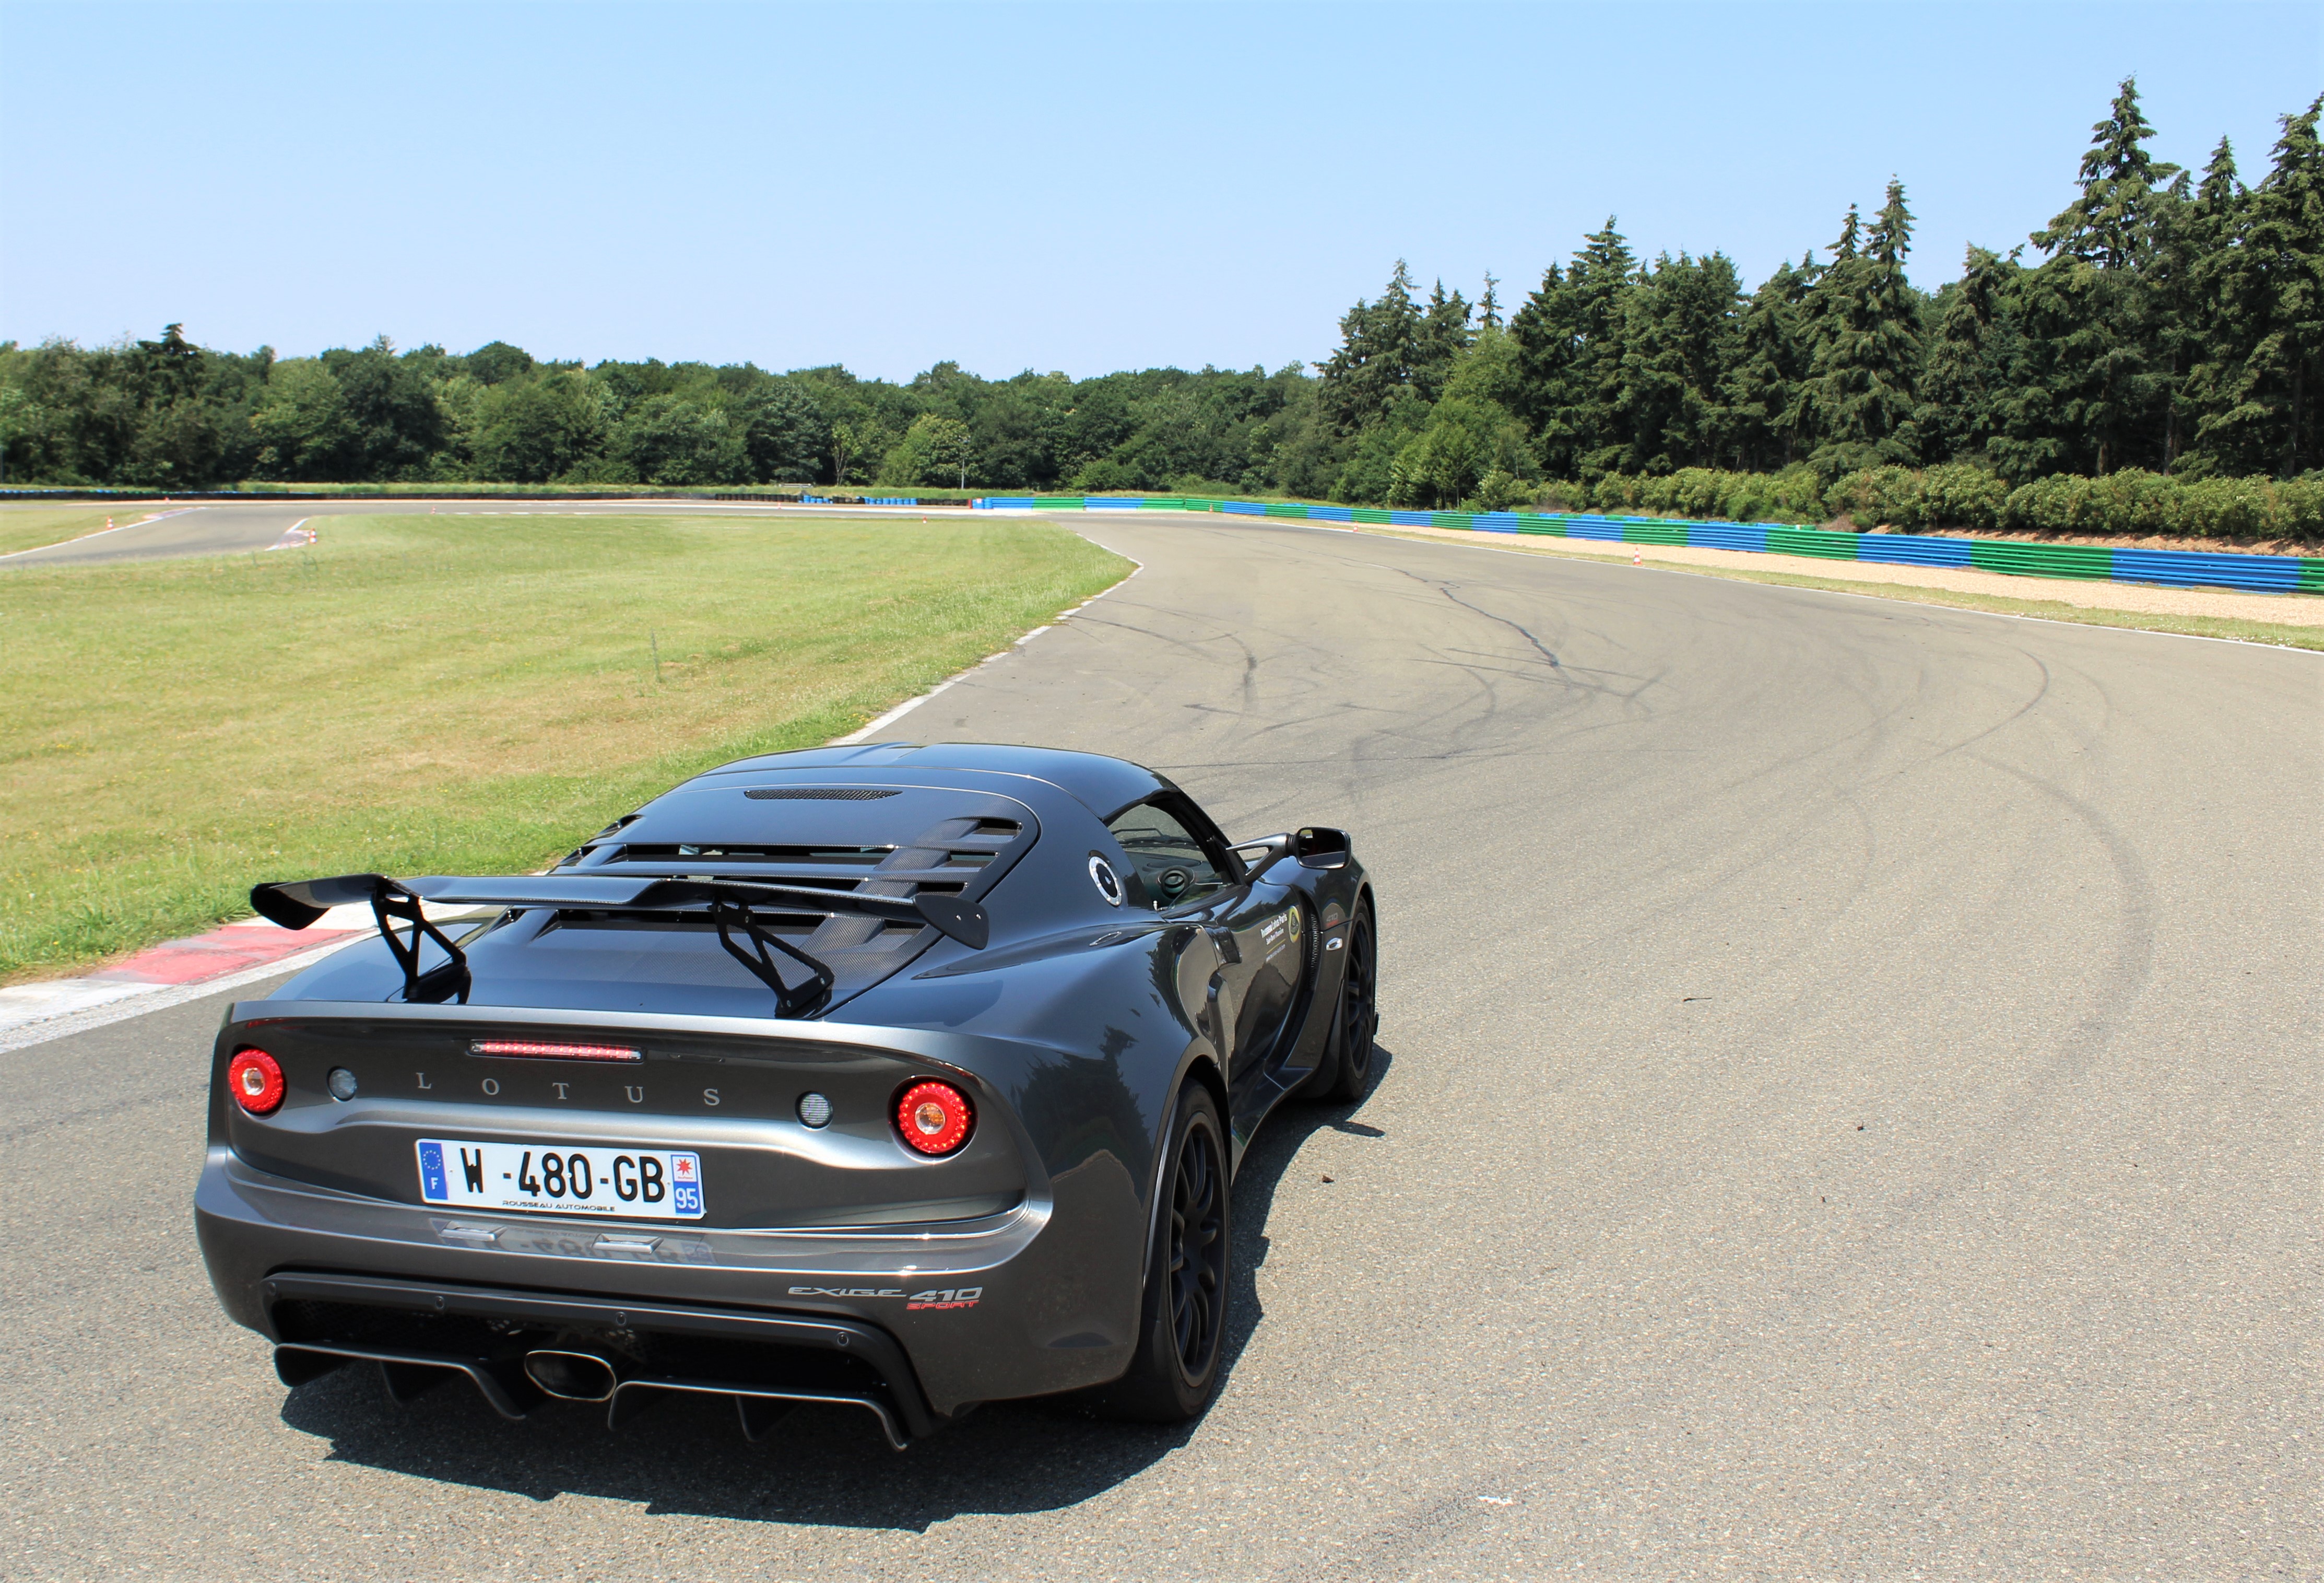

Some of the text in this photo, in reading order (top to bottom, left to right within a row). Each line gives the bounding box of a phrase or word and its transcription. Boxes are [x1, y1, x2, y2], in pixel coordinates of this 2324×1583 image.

[416, 1072, 721, 1106] LOTUS
[431, 1177, 439, 1190] F
[675, 1187, 699, 1210] 95
[502, 1200, 616, 1212] ROUSSEAU AUTOMOBILE
[788, 1286, 983, 1302] EXIGE 410
[906, 1299, 980, 1310] SPORT
